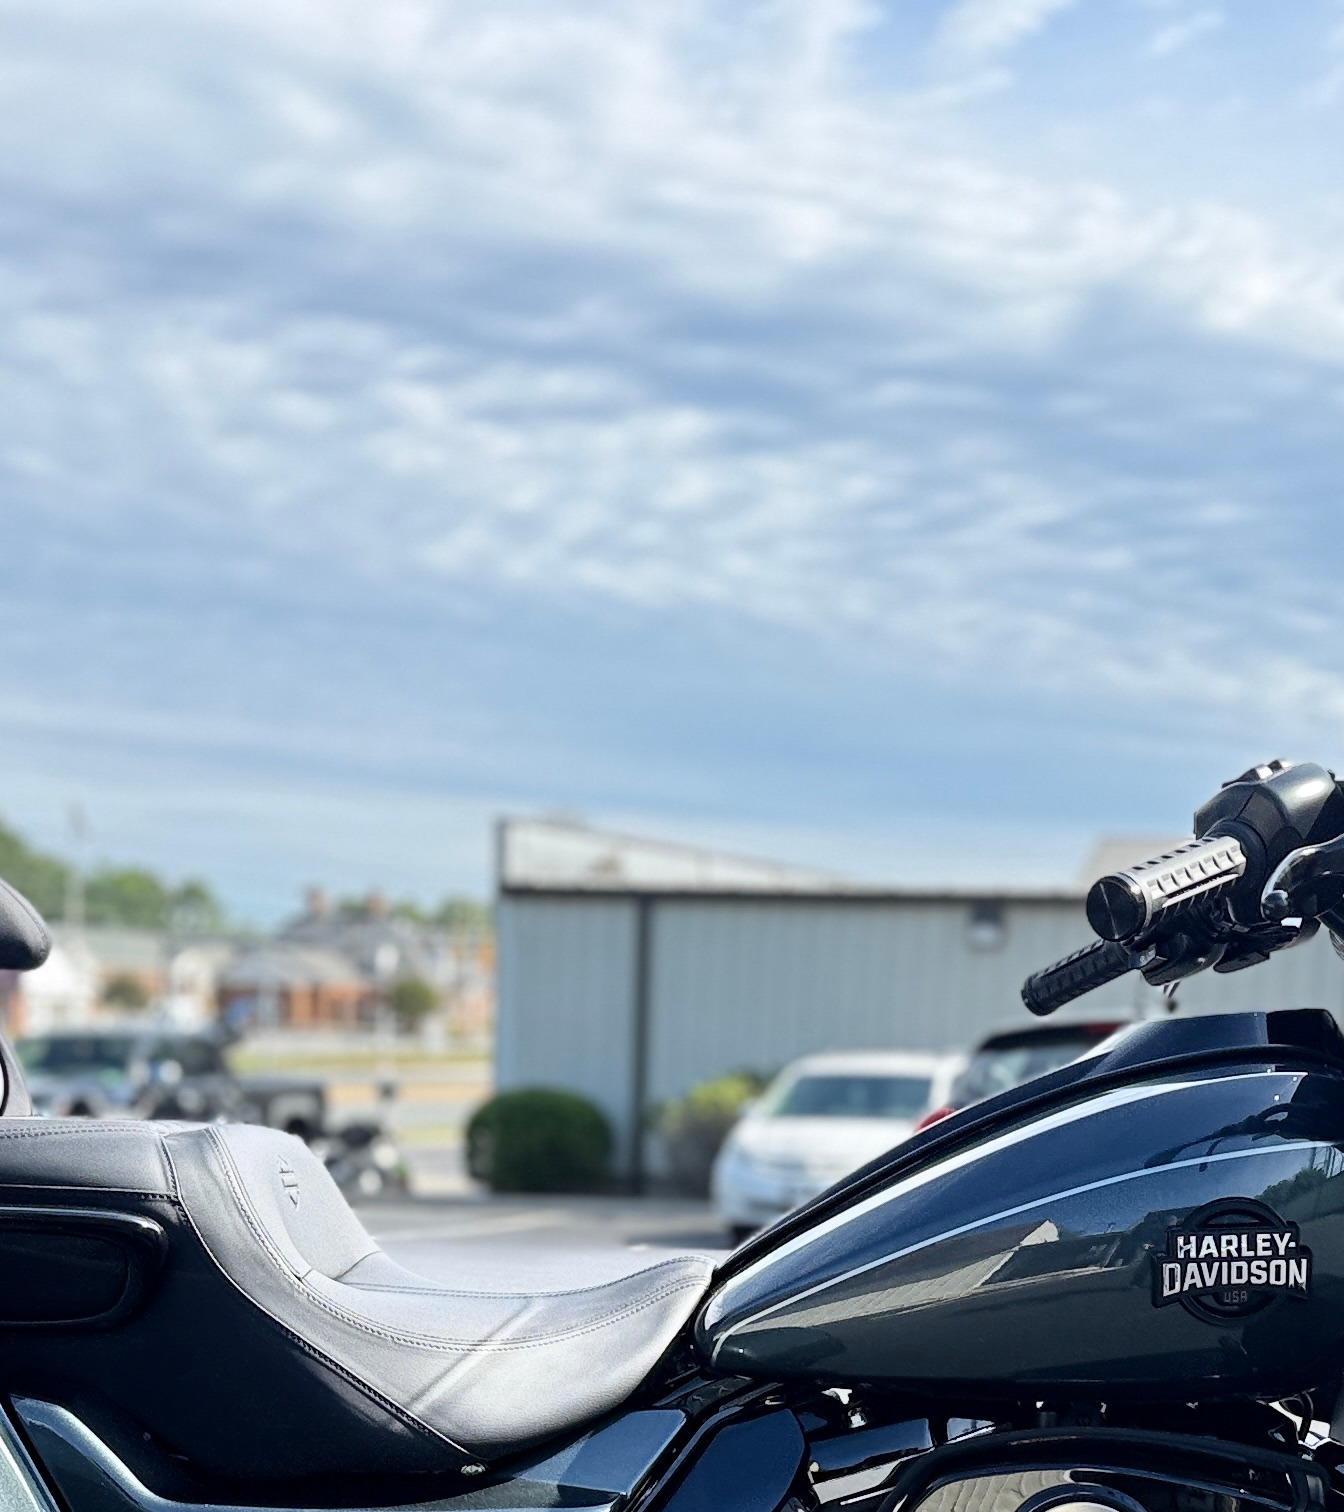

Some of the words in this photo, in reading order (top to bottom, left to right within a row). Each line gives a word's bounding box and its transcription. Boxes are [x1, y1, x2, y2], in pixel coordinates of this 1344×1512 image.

[1177, 1232, 1296, 1259] HARLEY-
[1162, 1258, 1307, 1297] DAVIDSON
[1224, 1290, 1248, 1303] USA
